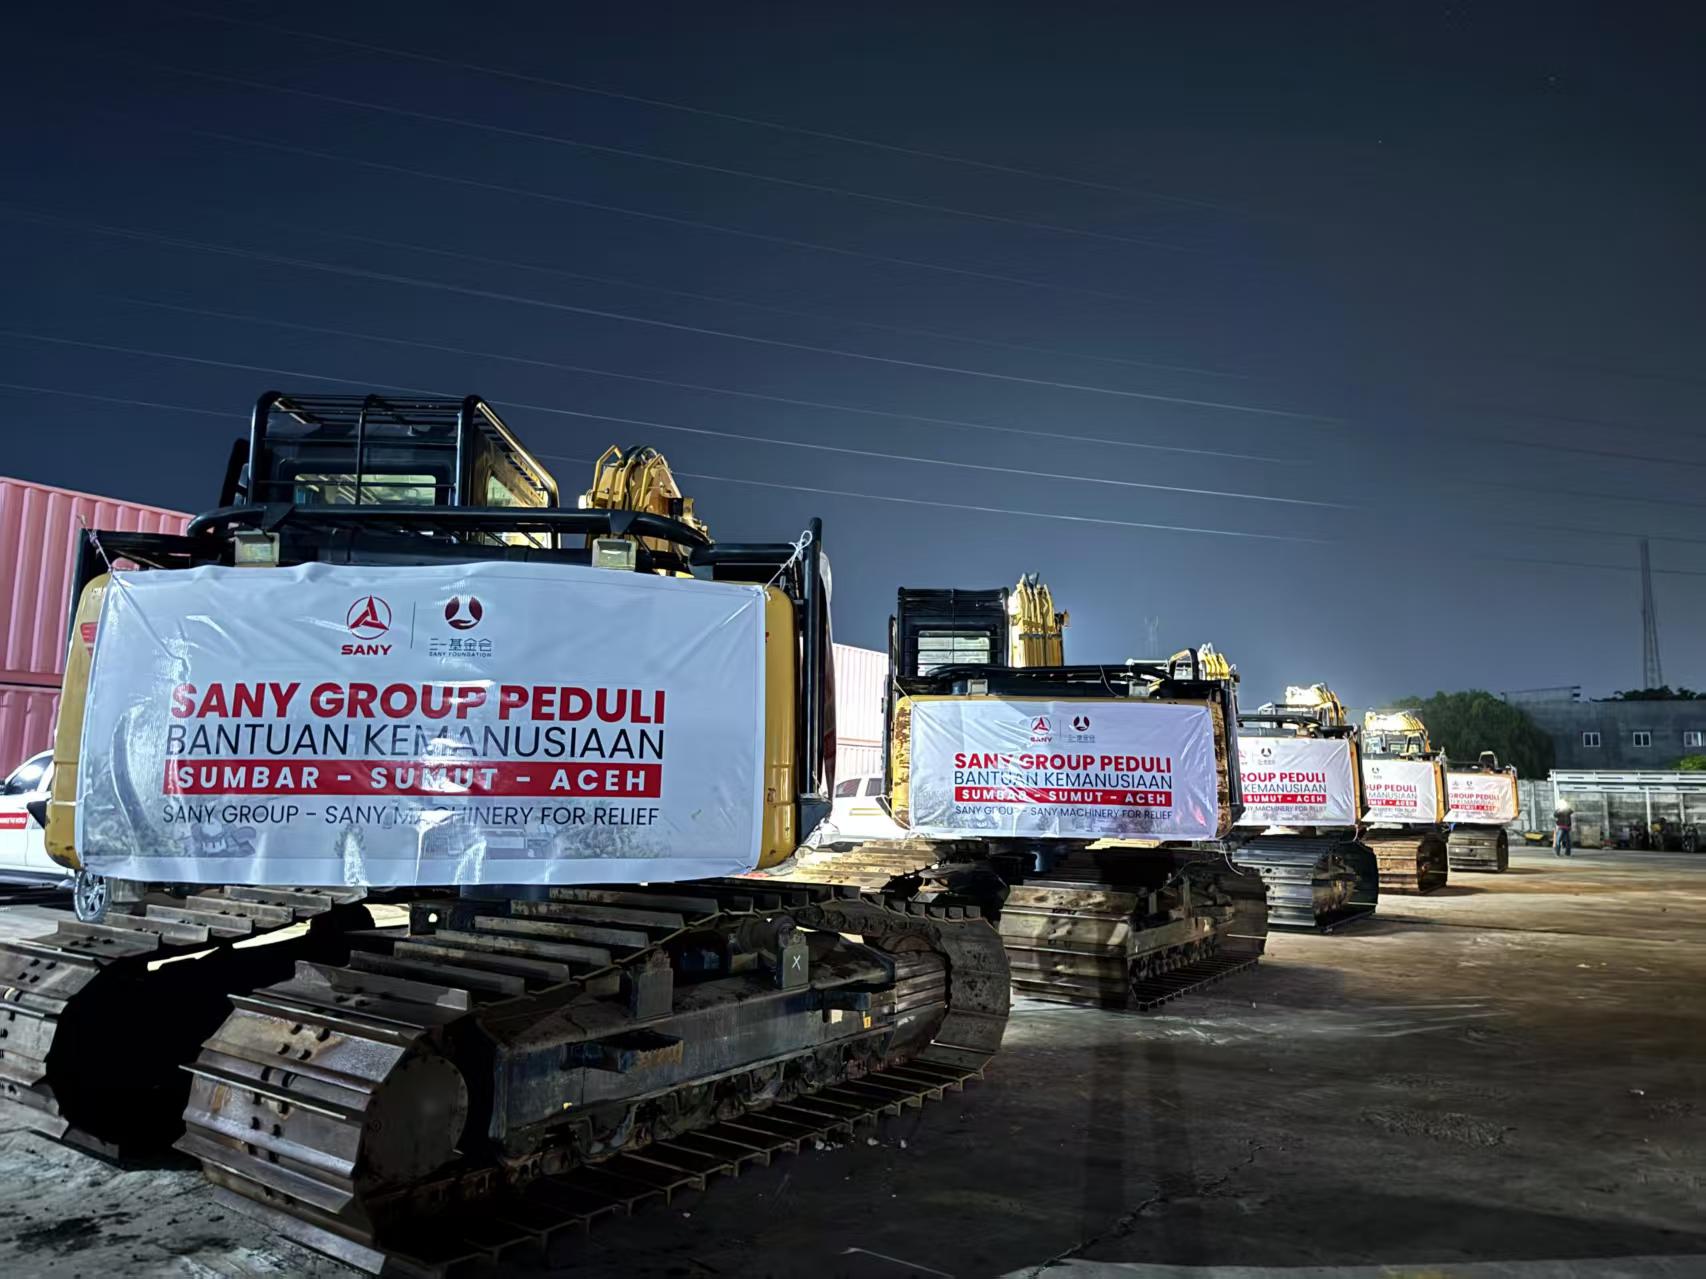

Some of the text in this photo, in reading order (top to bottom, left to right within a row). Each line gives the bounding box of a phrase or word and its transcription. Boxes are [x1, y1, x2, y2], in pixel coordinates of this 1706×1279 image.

[341, 644, 392, 656] SANY
[171, 682, 665, 724] SANY GROUP PEDULI
[165, 723, 664, 760] BANTUAN KEMANUSIAAN
[1018, 753, 1096, 771] GROUP
[1100, 755, 1172, 774] PEDULI
[177, 766, 320, 789] SUMBAR
[370, 767, 498, 790] SUMUT
[550, 769, 646, 792] ACEH
[1044, 771, 1172, 790] KEMANUSIAAN
[1239, 772, 1326, 783] ROUP PEDULI
[1243, 783, 1327, 793] KEMANUSIAAN
[1048, 790, 1103, 802] SUMUT
[1124, 792, 1166, 805] ACEH
[1247, 795, 1282, 803] SUMUT
[1296, 795, 1323, 803] ACEH
[162, 805, 215, 824] SANY
[221, 805, 299, 824] GROUP
[325, 805, 387, 824] SANY
[394, 806, 534, 825] MHINERY
[540, 806, 586, 825] FOR
[593, 806, 660, 826] RELIEF
[955, 805, 981, 815] SANY
[984, 805, 1017, 816] GOU
[1030, 806, 1057, 816] SANY
[1060, 807, 1119, 818] MACHINERY
[1122, 809, 1143, 819] FOR
[1144, 810, 1173, 820] RELIEF
